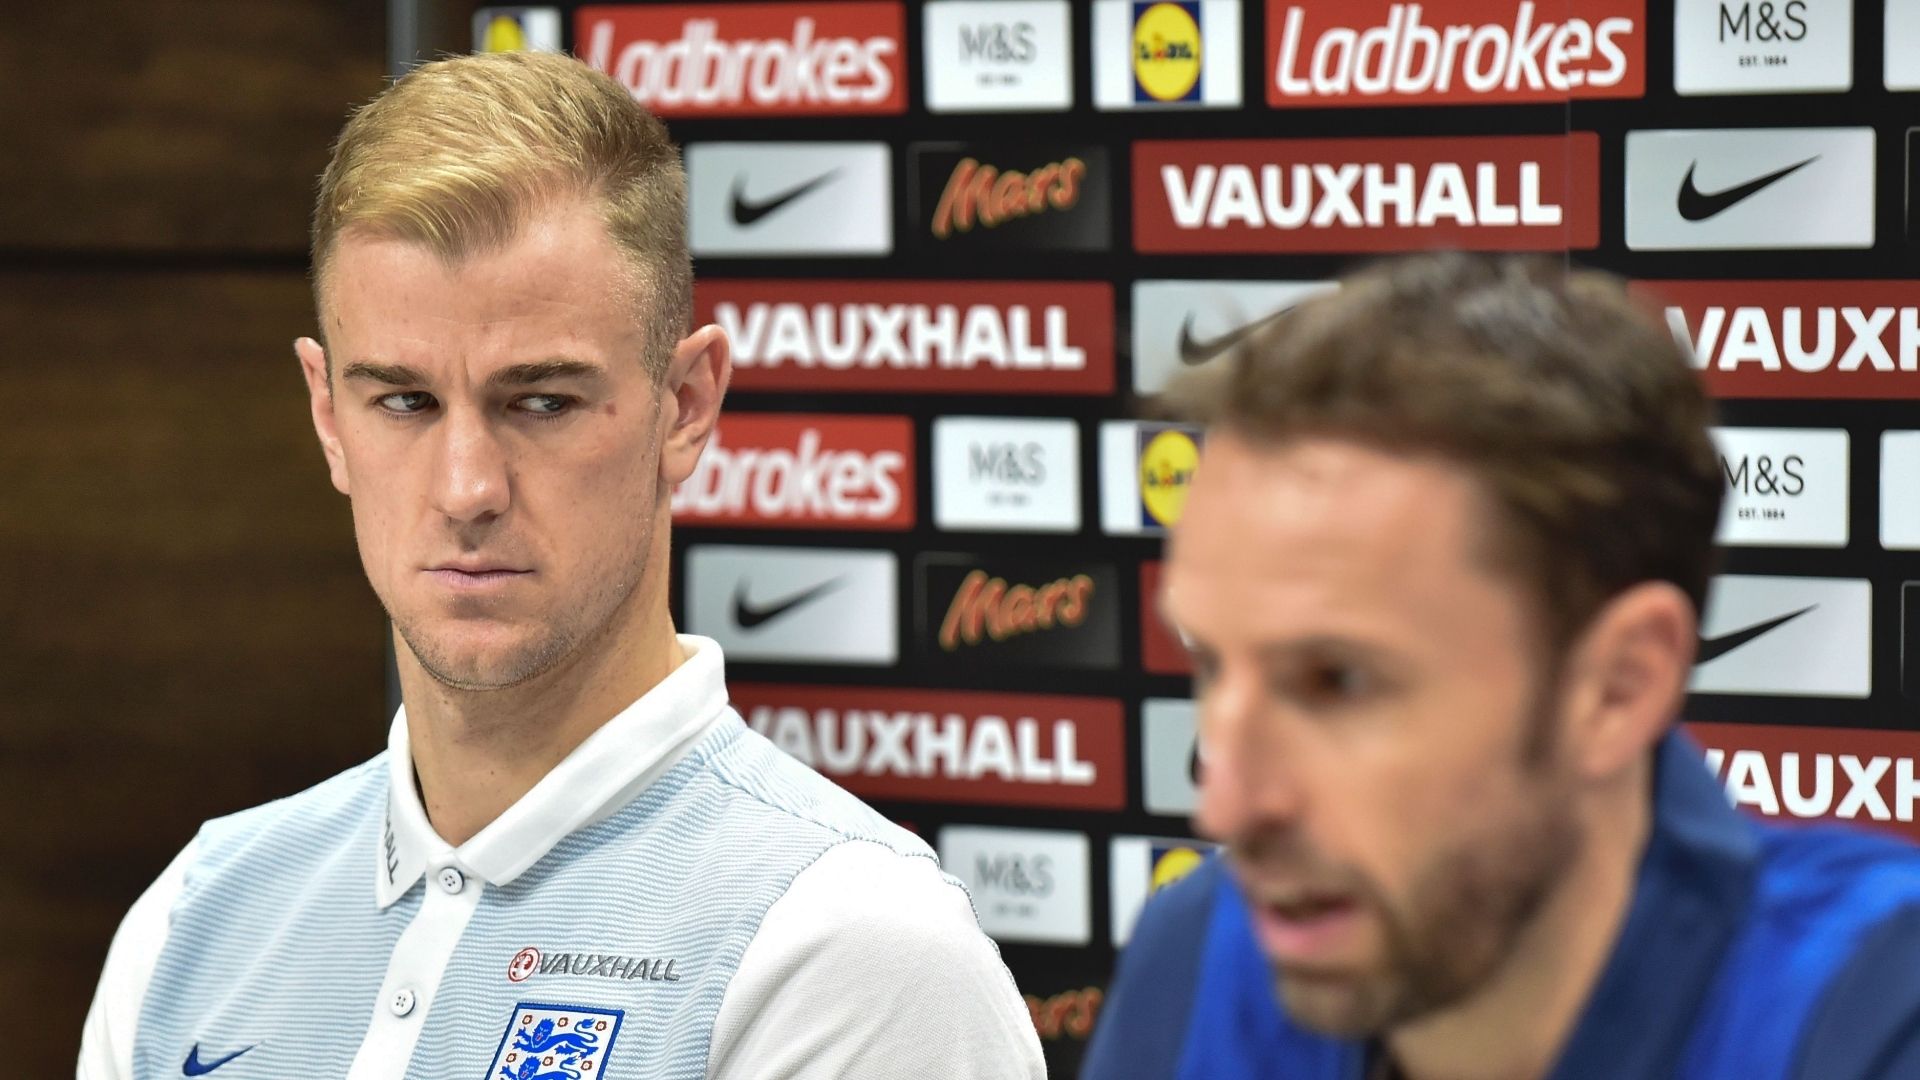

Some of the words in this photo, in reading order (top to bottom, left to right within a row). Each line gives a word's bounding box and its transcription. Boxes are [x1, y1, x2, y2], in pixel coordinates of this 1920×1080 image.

[958, 21, 1037, 64] M&S
[1719, 0, 1808, 42] M&S
[1276, 0, 1633, 96] Ladbrokes
[931, 157, 1086, 240] Mars
[1160, 161, 1563, 229] VAUXHALL
[714, 302, 1087, 370] VAUXHALL
[968, 440, 1047, 486] M&S
[1719, 454, 1805, 496] M&S
[939, 569, 1096, 650] Mars
[974, 854, 1054, 900] M&S
[538, 953, 681, 982] VAUXHALL
